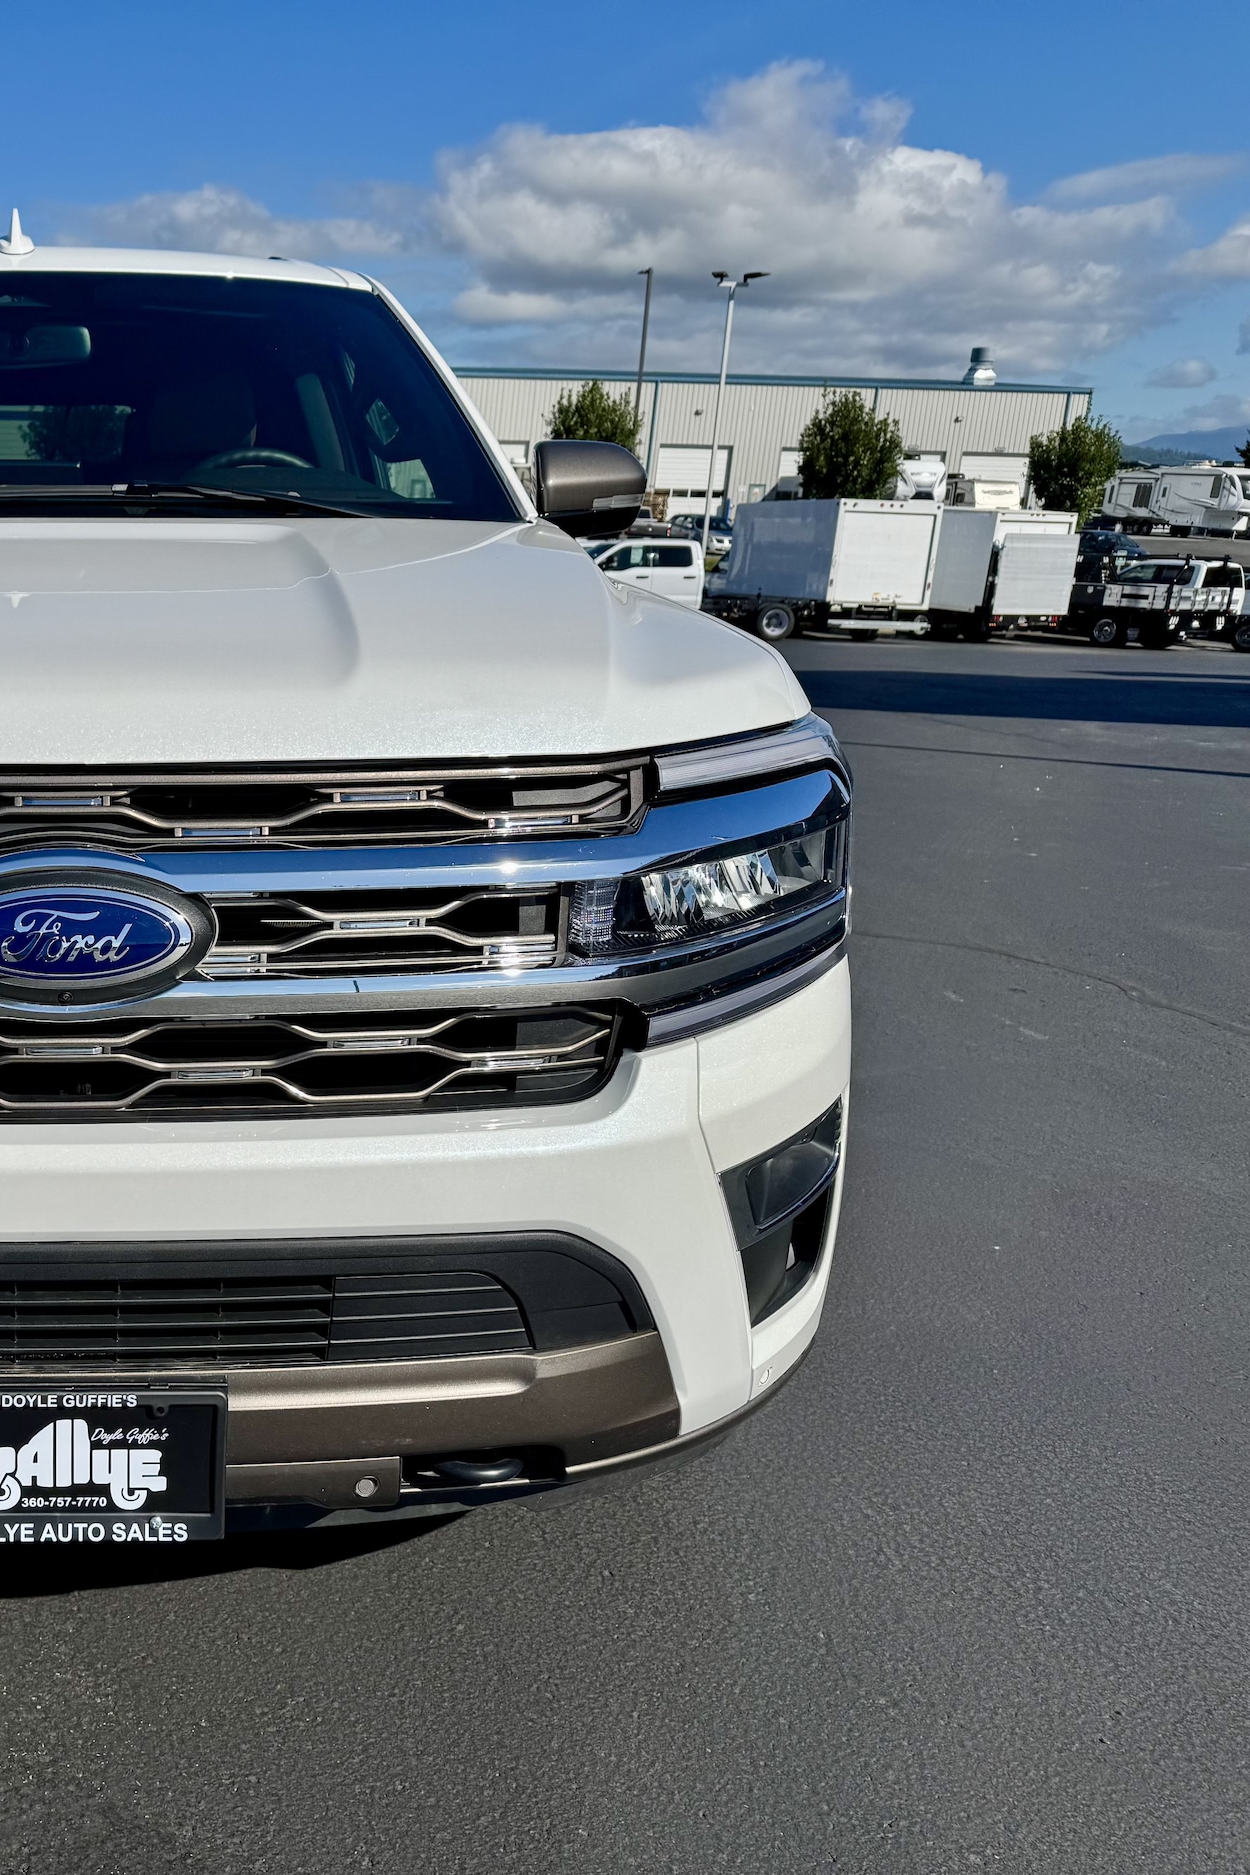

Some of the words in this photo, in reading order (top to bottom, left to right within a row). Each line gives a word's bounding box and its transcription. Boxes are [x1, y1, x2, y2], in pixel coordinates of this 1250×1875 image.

[1, 908, 134, 963] Ford
[1, 1394, 58, 1408] DOYLE
[62, 1394, 138, 1408] GUFFIE'S
[91, 1428, 124, 1444] Doyle
[126, 1428, 170, 1444] Guffie's
[21, 1497, 107, 1508] 360-757-7770
[40, 1523, 106, 1542] AUTO
[111, 1523, 188, 1542] SALES
